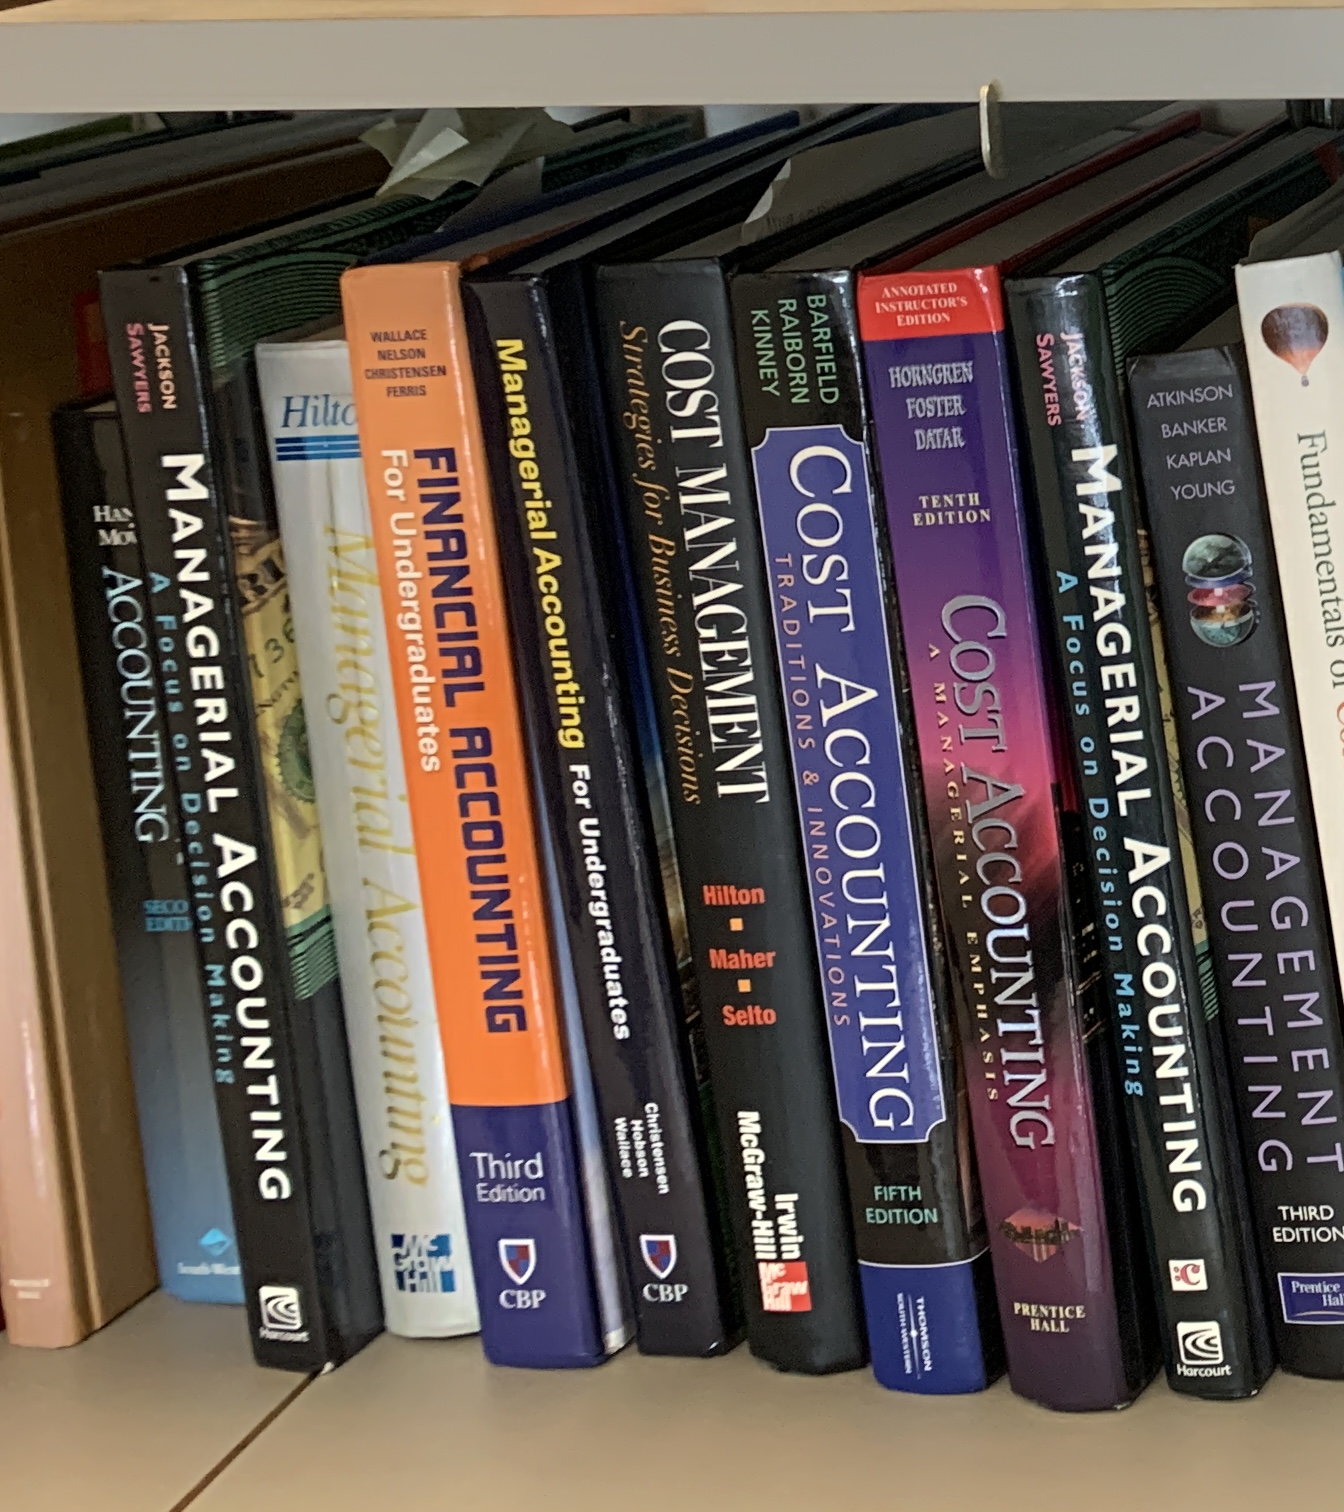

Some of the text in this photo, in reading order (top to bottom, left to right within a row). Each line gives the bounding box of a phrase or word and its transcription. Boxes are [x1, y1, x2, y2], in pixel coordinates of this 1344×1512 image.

[370, 328, 428, 343] WALLACE
[377, 346, 426, 361] NELSON
[750, 309, 780, 397] KINNEY
[807, 293, 840, 404] BARFIELD
[889, 361, 974, 388] HORNGREN
[386, 384, 427, 397] FERRIS
[1147, 384, 1233, 409] ATKINSON
[1162, 416, 1227, 438] BANKER
[1166, 449, 1232, 469] KAPLAN
[919, 494, 981, 509] TENTH
[1170, 480, 1235, 501] YOUNG
[913, 509, 992, 526] EDITION
[657, 319, 771, 803] COST MANAGEMENT
[381, 449, 440, 773] For Undergraduates
[495, 338, 630, 1040] Managerial Accounting For Undergraduates
[414, 446, 528, 1033] FINANCIAL ACCOUNTING
[788, 444, 916, 1131] COST ACCOUNTING
[161, 453, 237, 814] MANAGERIAL
[212, 832, 291, 1201] ACCOUNTING
[704, 886, 765, 906] Hilton
[709, 948, 776, 970] Maher
[722, 1005, 776, 1026] Selto
[469, 1154, 544, 1180] Third
[476, 1182, 545, 1203] Edition
[874, 1185, 922, 1202] FIFTH
[866, 1207, 938, 1226] EDITION
